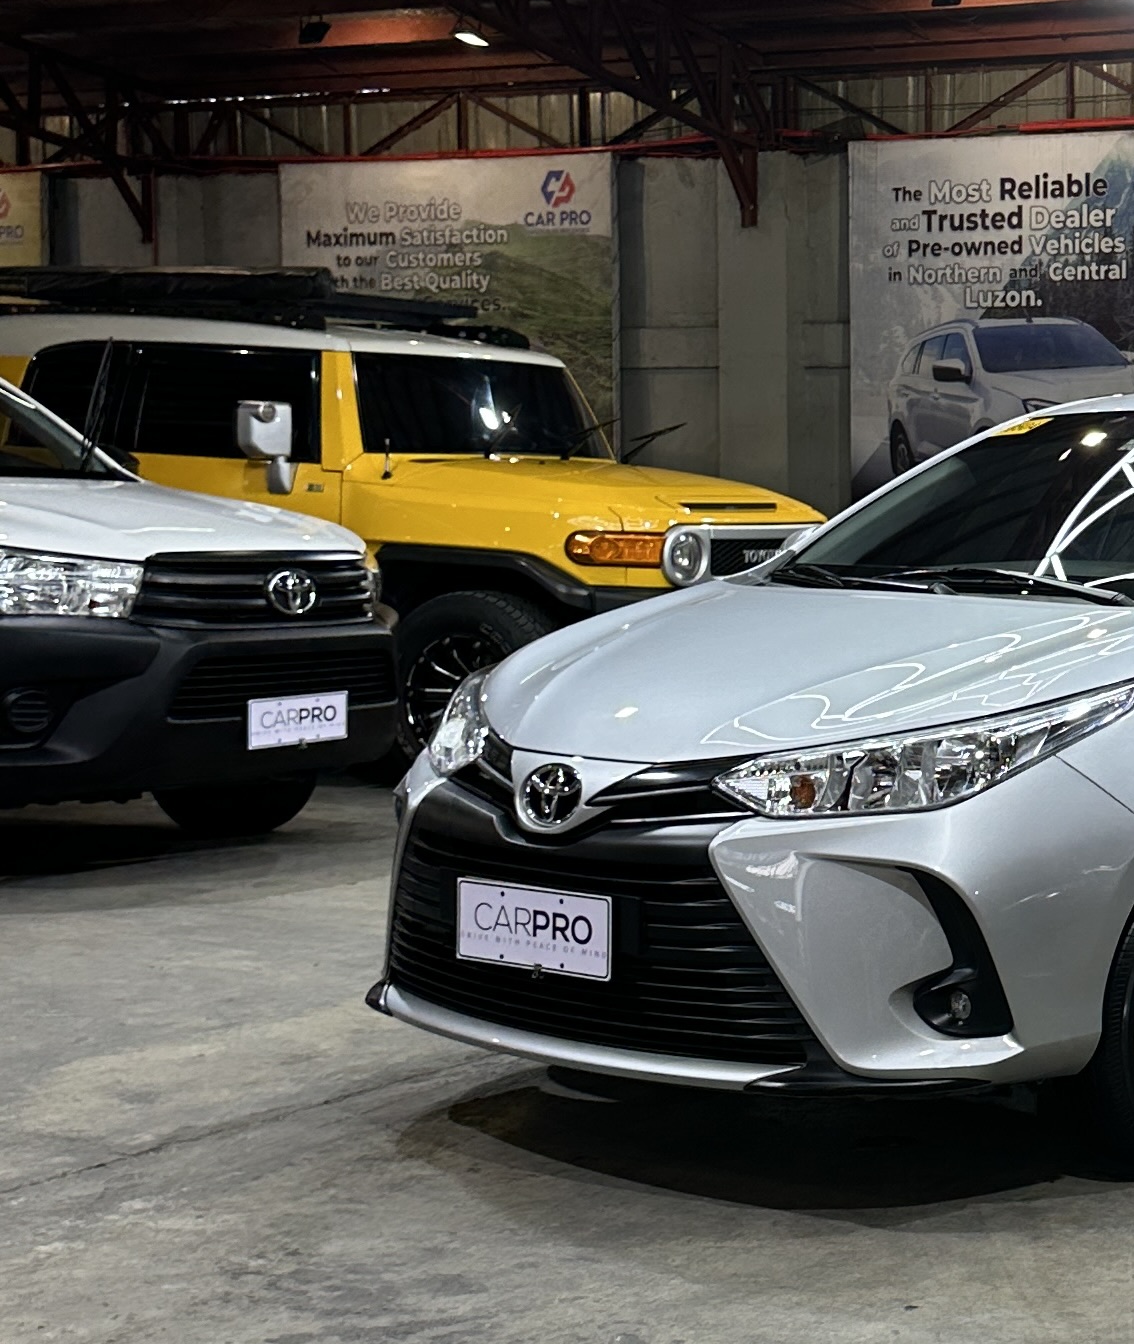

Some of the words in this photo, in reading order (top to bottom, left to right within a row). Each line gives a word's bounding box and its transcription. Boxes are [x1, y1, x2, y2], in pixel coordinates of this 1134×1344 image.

[892, 186, 922, 202] The
[929, 179, 992, 205] Most
[1000, 172, 1108, 201] Reliable
[346, 202, 379, 223] We
[384, 197, 462, 222] Provide
[524, 212, 555, 227] CAR
[560, 210, 592, 225] PRO
[890, 215, 920, 232] and
[922, 205, 1023, 233] Trusted
[1029, 204, 1117, 230] Dealer
[306, 227, 396, 248] Maximum
[401, 224, 508, 246] Satisfaction
[882, 241, 900, 258] of
[908, 235, 1023, 257] Pre-owned
[1028, 232, 1126, 255] Vehicles
[336, 254, 351, 268] to
[355, 256, 379, 268] our
[386, 251, 482, 269] Customers
[381, 272, 420, 291] Best
[425, 270, 490, 293] Quality
[888, 267, 902, 281] in
[908, 263, 1001, 285] Northern
[1009, 264, 1038, 279] and
[1049, 260, 1127, 281] Central
[964, 286, 1043, 308] Luzon.
[261, 705, 337, 729] CARPRO
[474, 902, 593, 945] CARPRO
